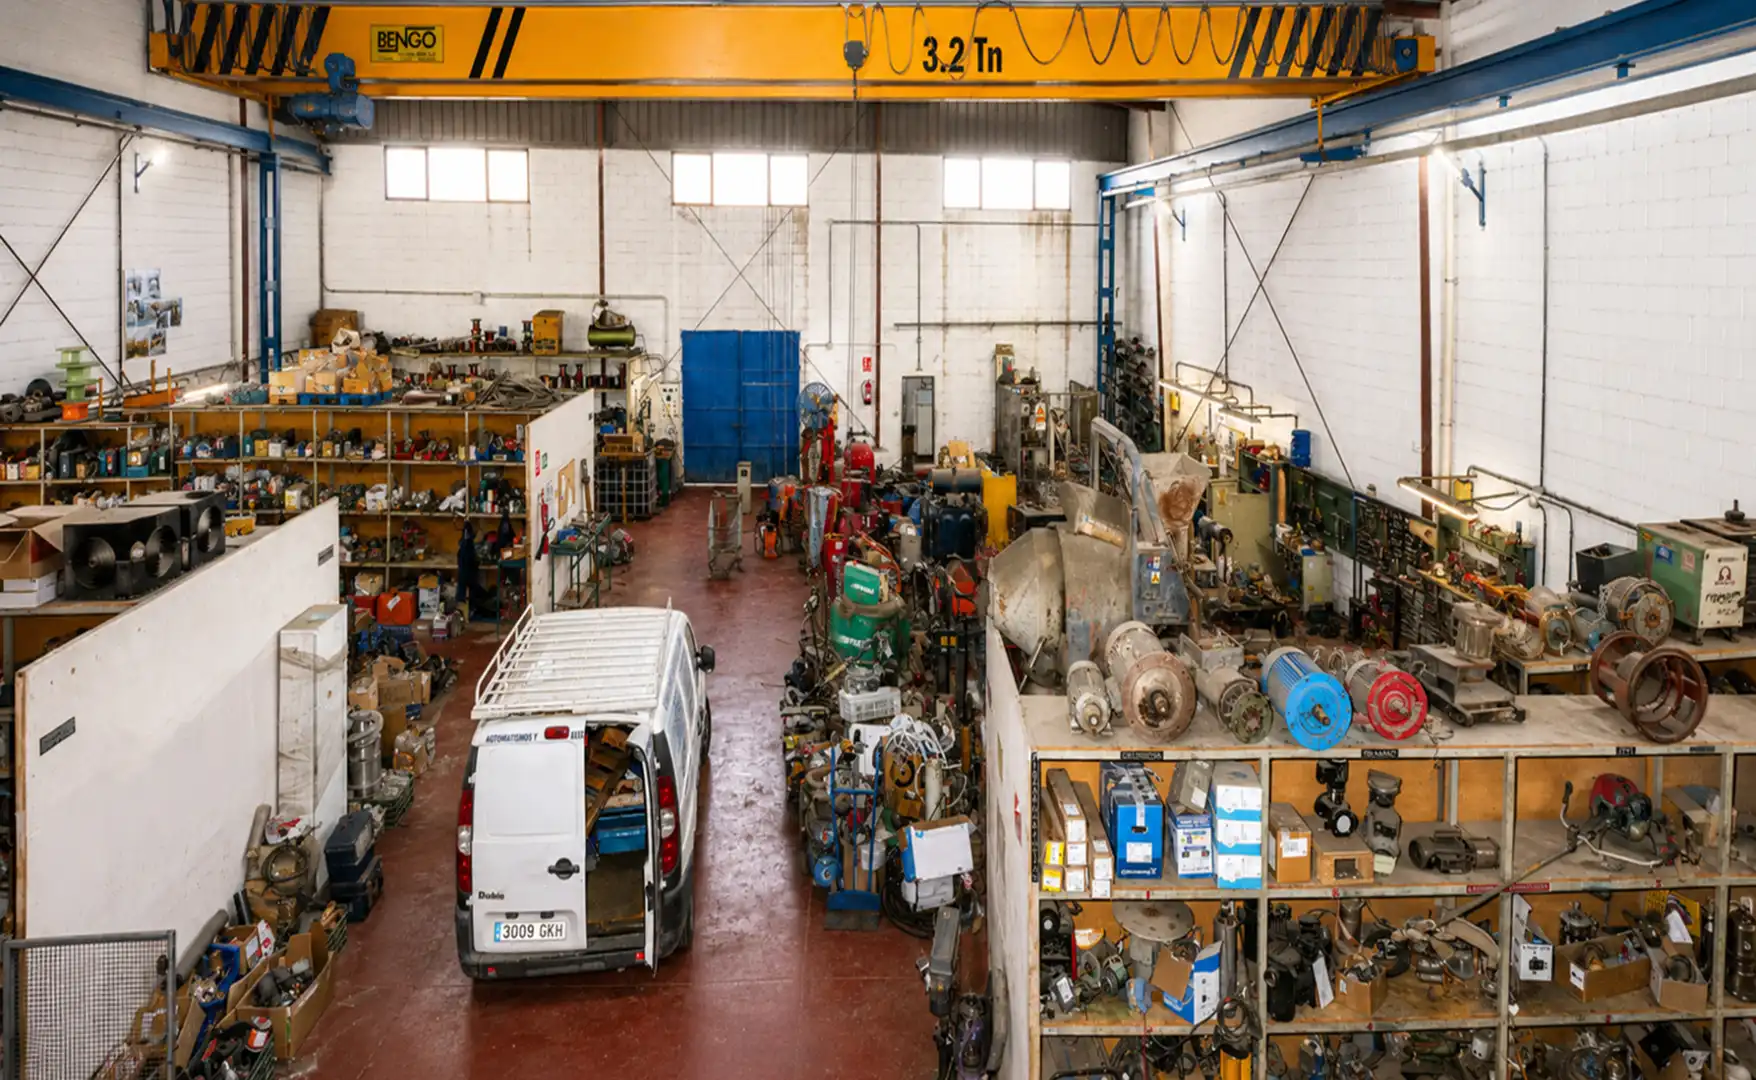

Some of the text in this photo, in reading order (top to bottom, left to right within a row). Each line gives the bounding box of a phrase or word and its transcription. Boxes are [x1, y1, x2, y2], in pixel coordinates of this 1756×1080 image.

[377, 27, 437, 52] BENGO
[922, 36, 1003, 73] 3.2 Tn
[502, 923, 563, 939] 3009 GKH
